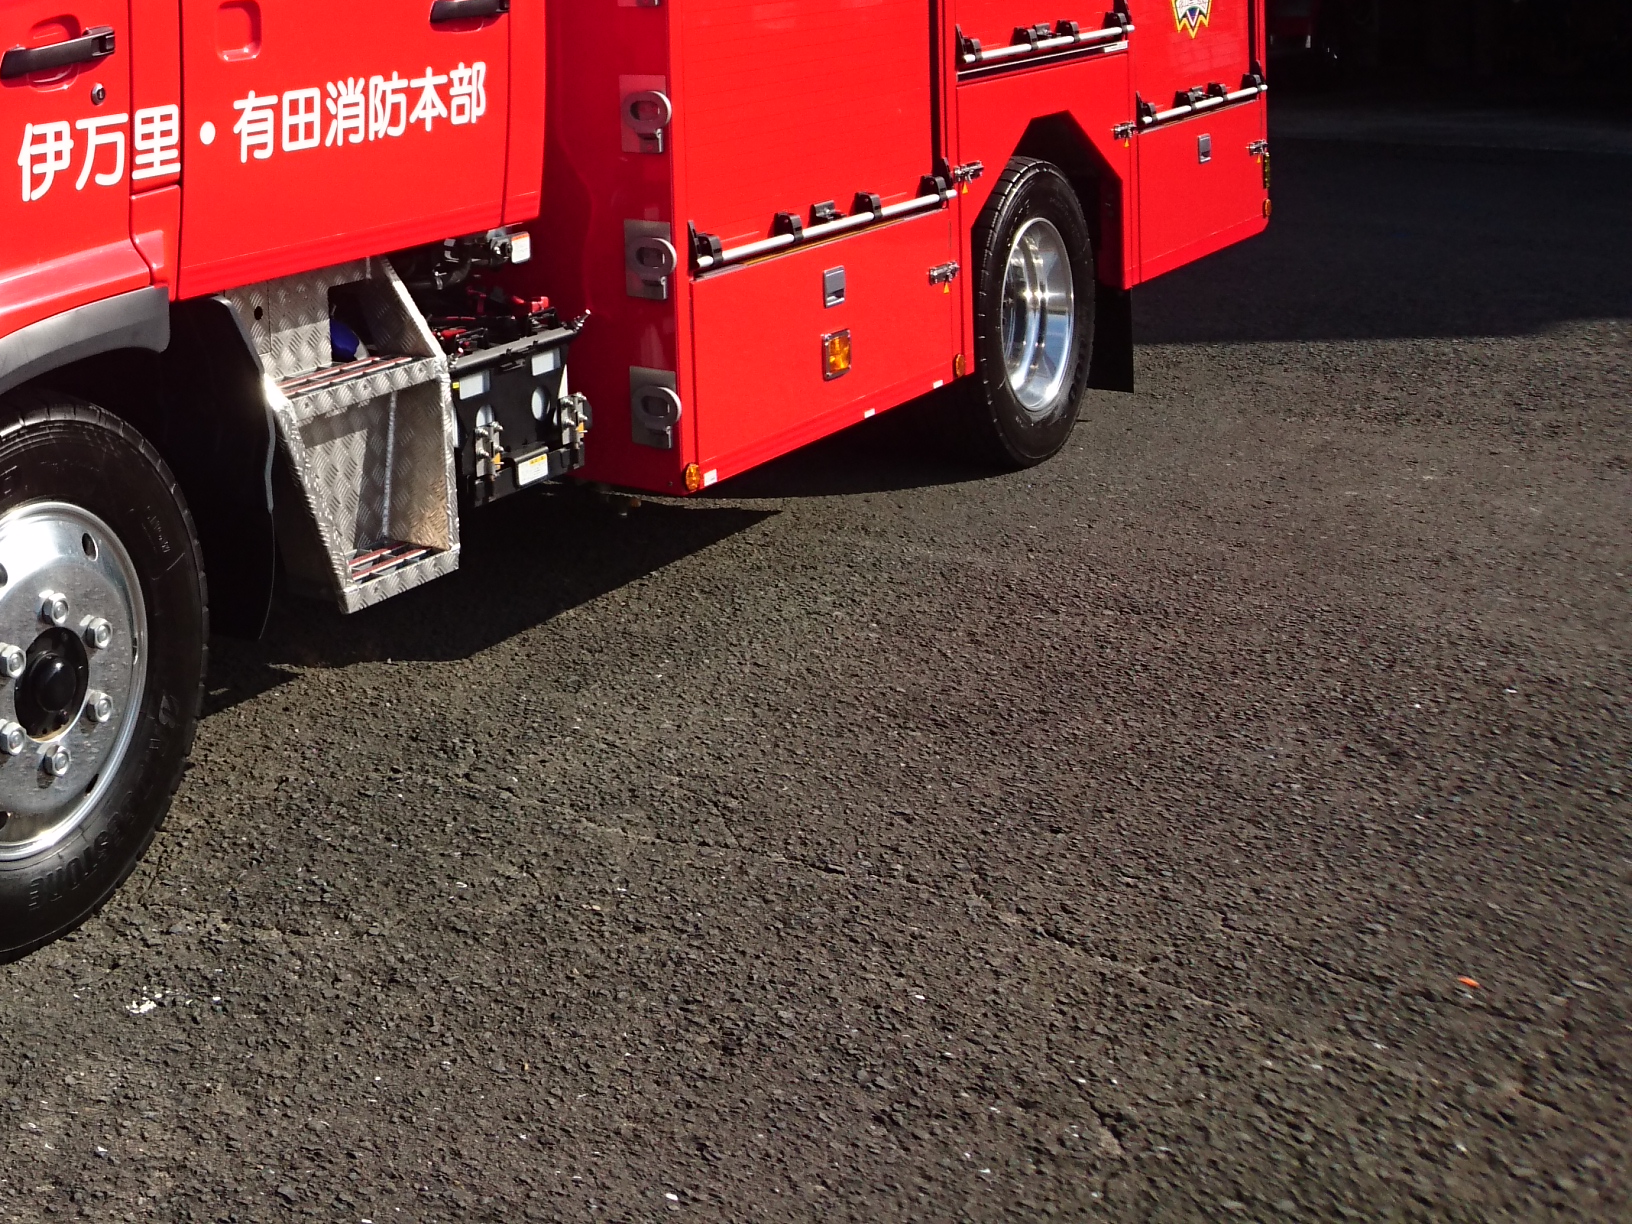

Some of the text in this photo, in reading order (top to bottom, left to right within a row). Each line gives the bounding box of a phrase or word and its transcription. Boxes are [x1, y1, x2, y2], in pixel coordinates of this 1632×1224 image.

[17, 61, 487, 202] 伊万里・有田消防本部
